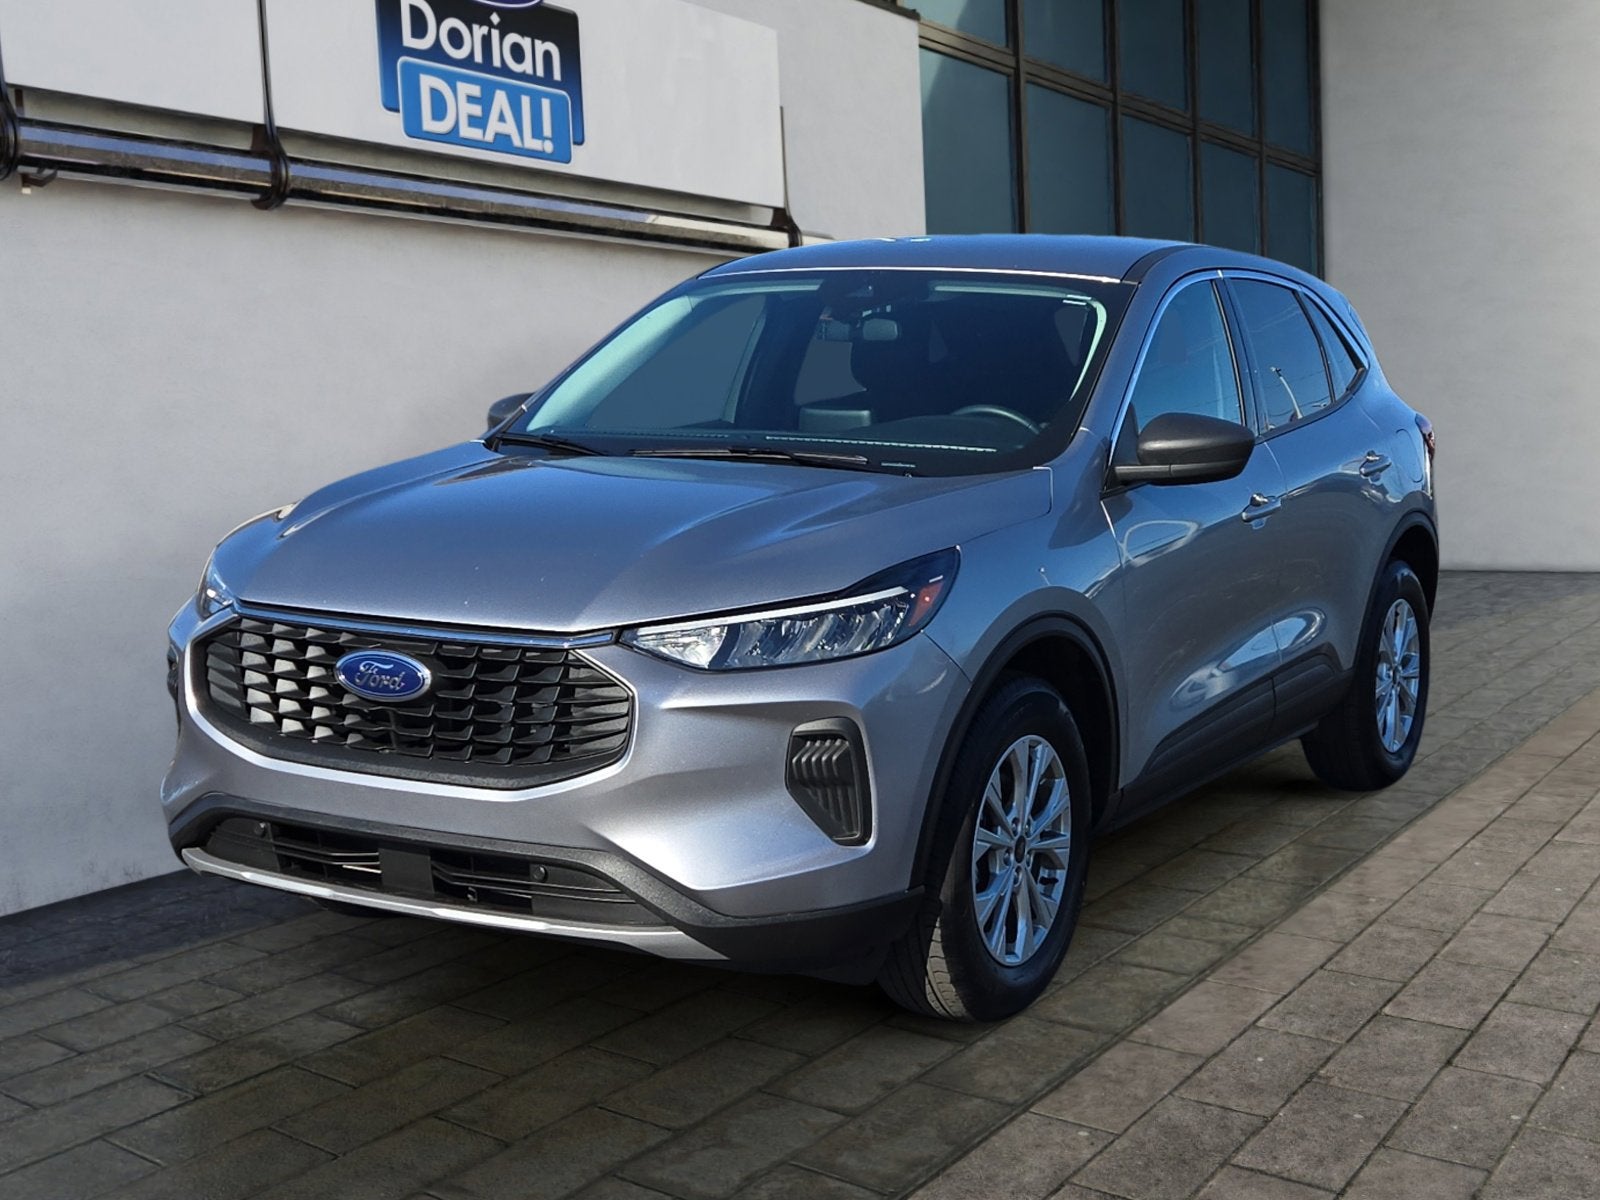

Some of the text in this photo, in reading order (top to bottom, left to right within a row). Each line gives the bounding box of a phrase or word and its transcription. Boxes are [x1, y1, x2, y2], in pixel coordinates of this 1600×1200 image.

[401, 0, 562, 81] Dorian
[419, 73, 554, 154] DEAL!
[354, 660, 405, 691] Ford
